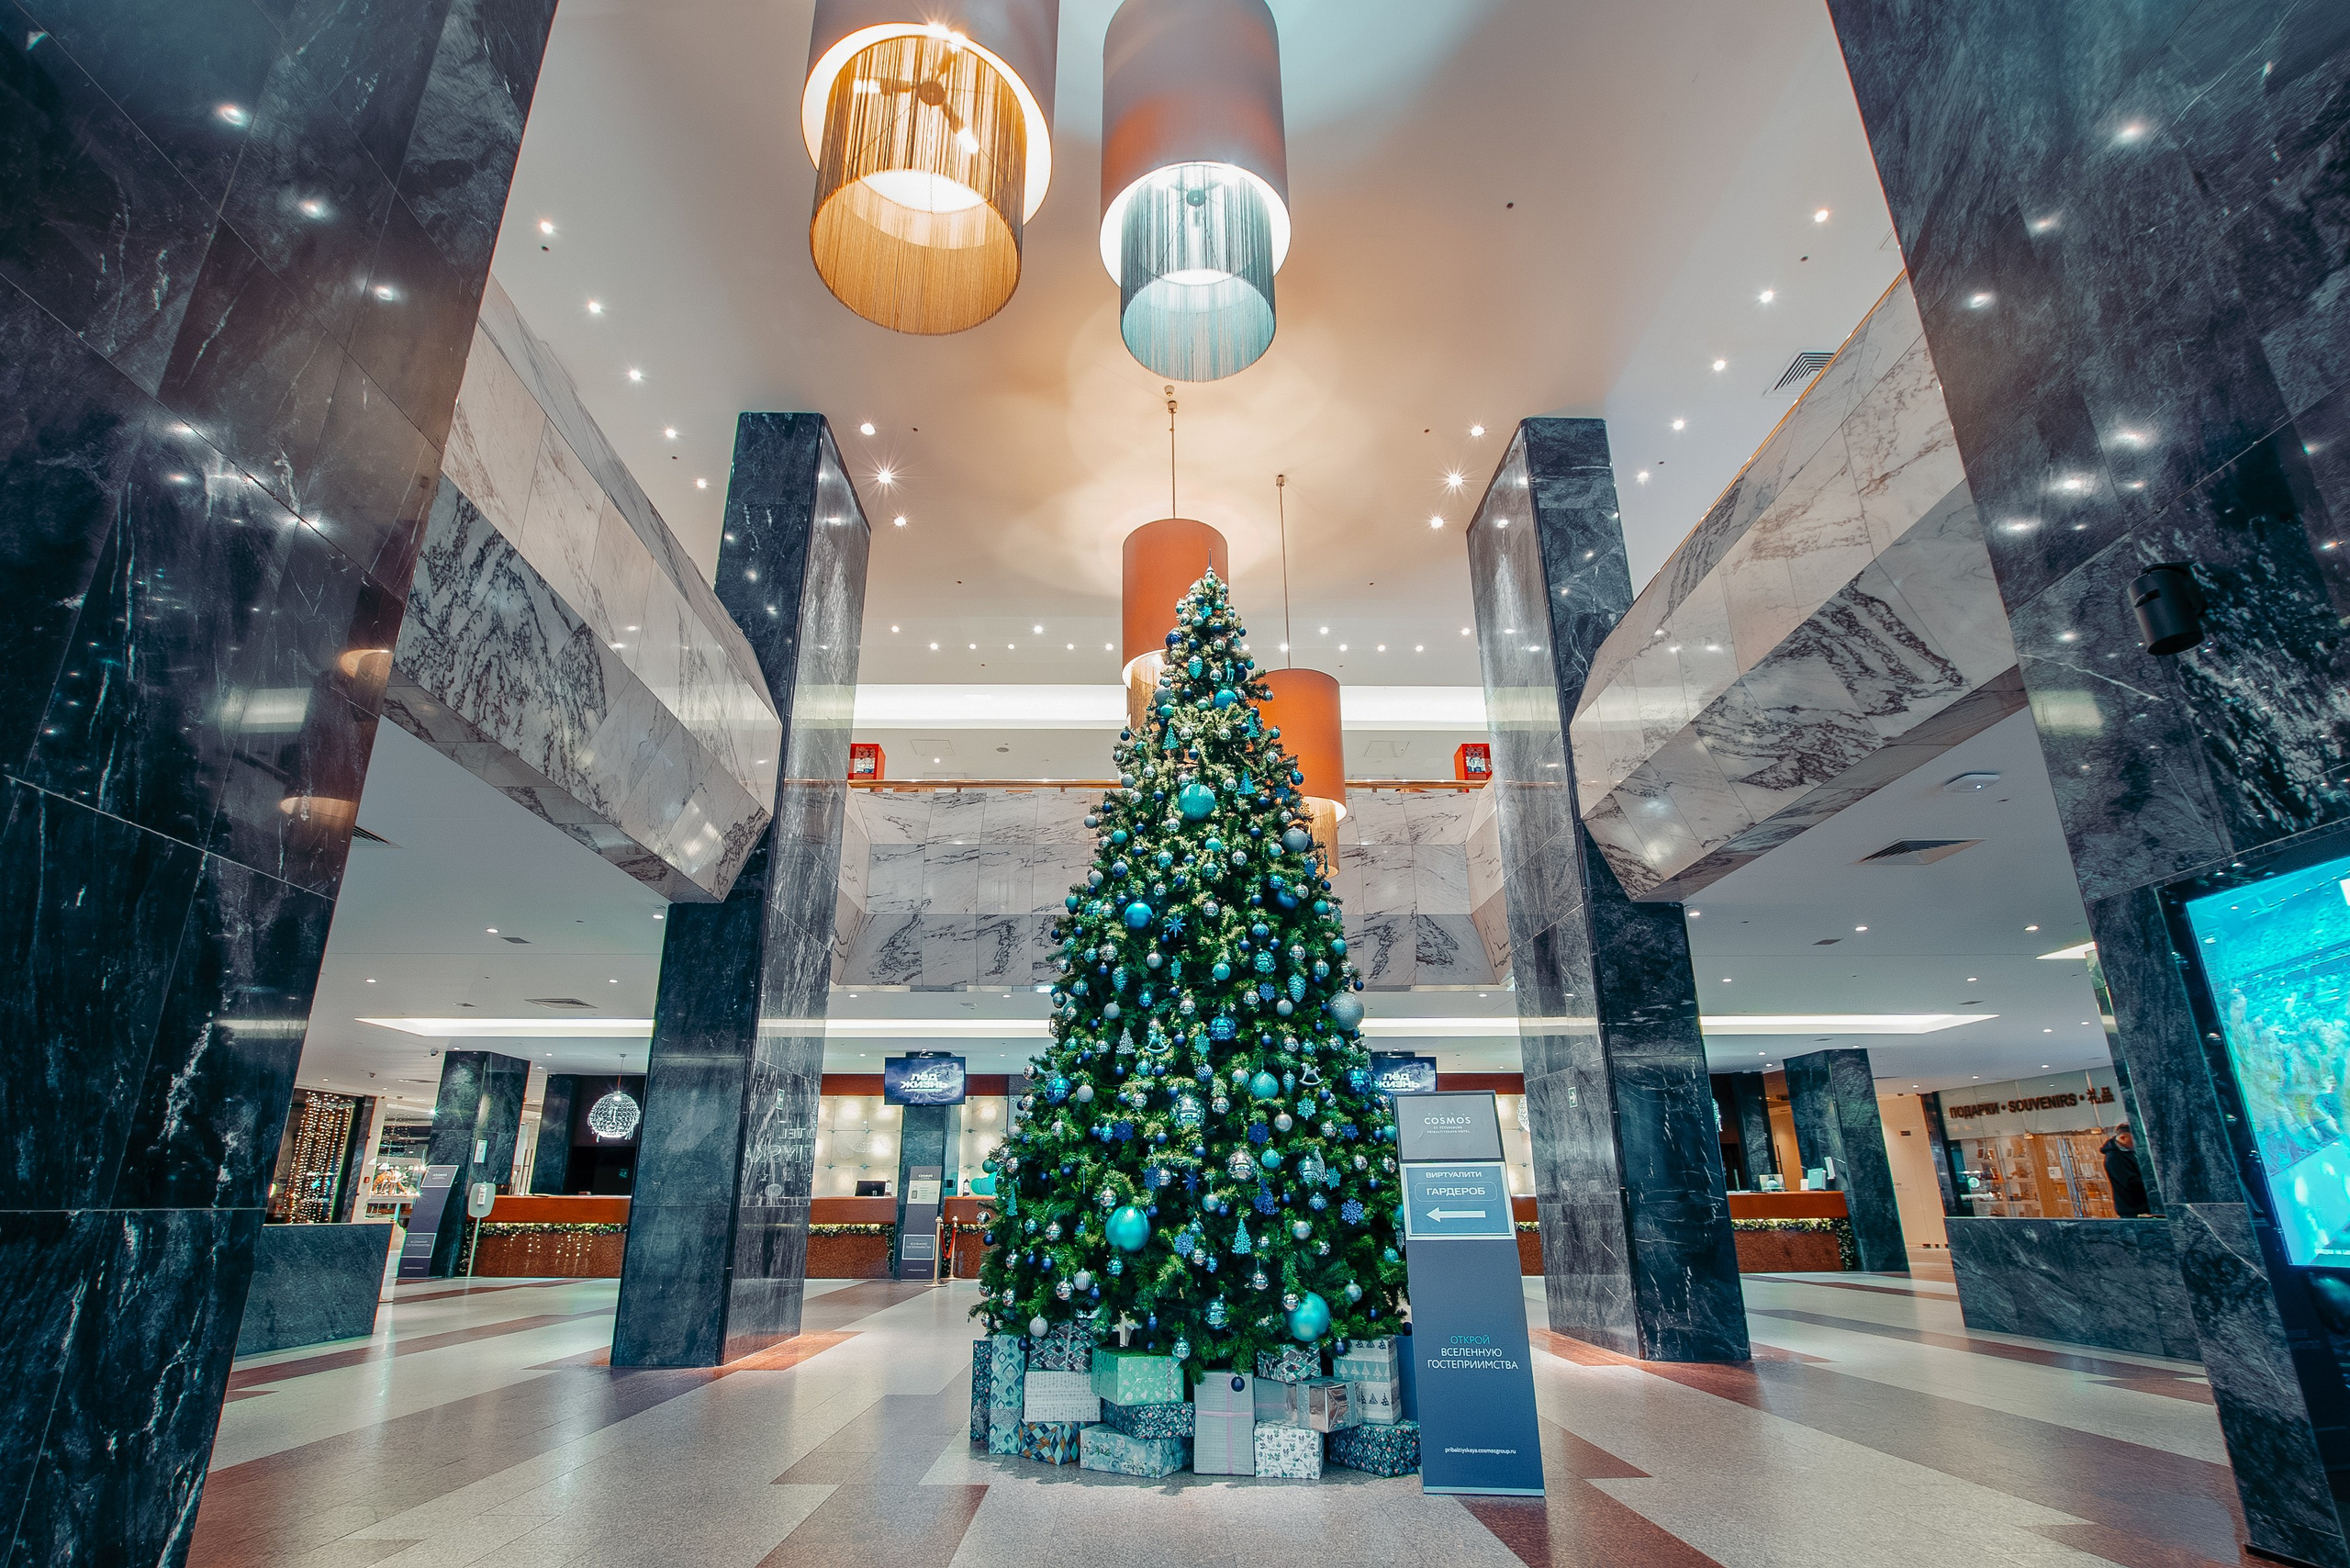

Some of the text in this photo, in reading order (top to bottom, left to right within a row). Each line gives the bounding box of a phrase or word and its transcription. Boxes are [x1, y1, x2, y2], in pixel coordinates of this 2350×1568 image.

[1949, 1086, 2115, 1119] ПОДАРКИ SOUVENIRS 礼品
[1424, 1116, 1472, 1125] COSMOS
[1426, 1170, 1483, 1179] ВИРТУАЛИТИ
[1427, 1187, 1485, 1197] ГАРДЕРОБ
[1450, 1335, 1490, 1345] ОТКРОЙ
[1440, 1348, 1503, 1358] ВСЕЛЕННУЮ
[1427, 1360, 1519, 1370] ГОСТЕПРИИМСТВА
